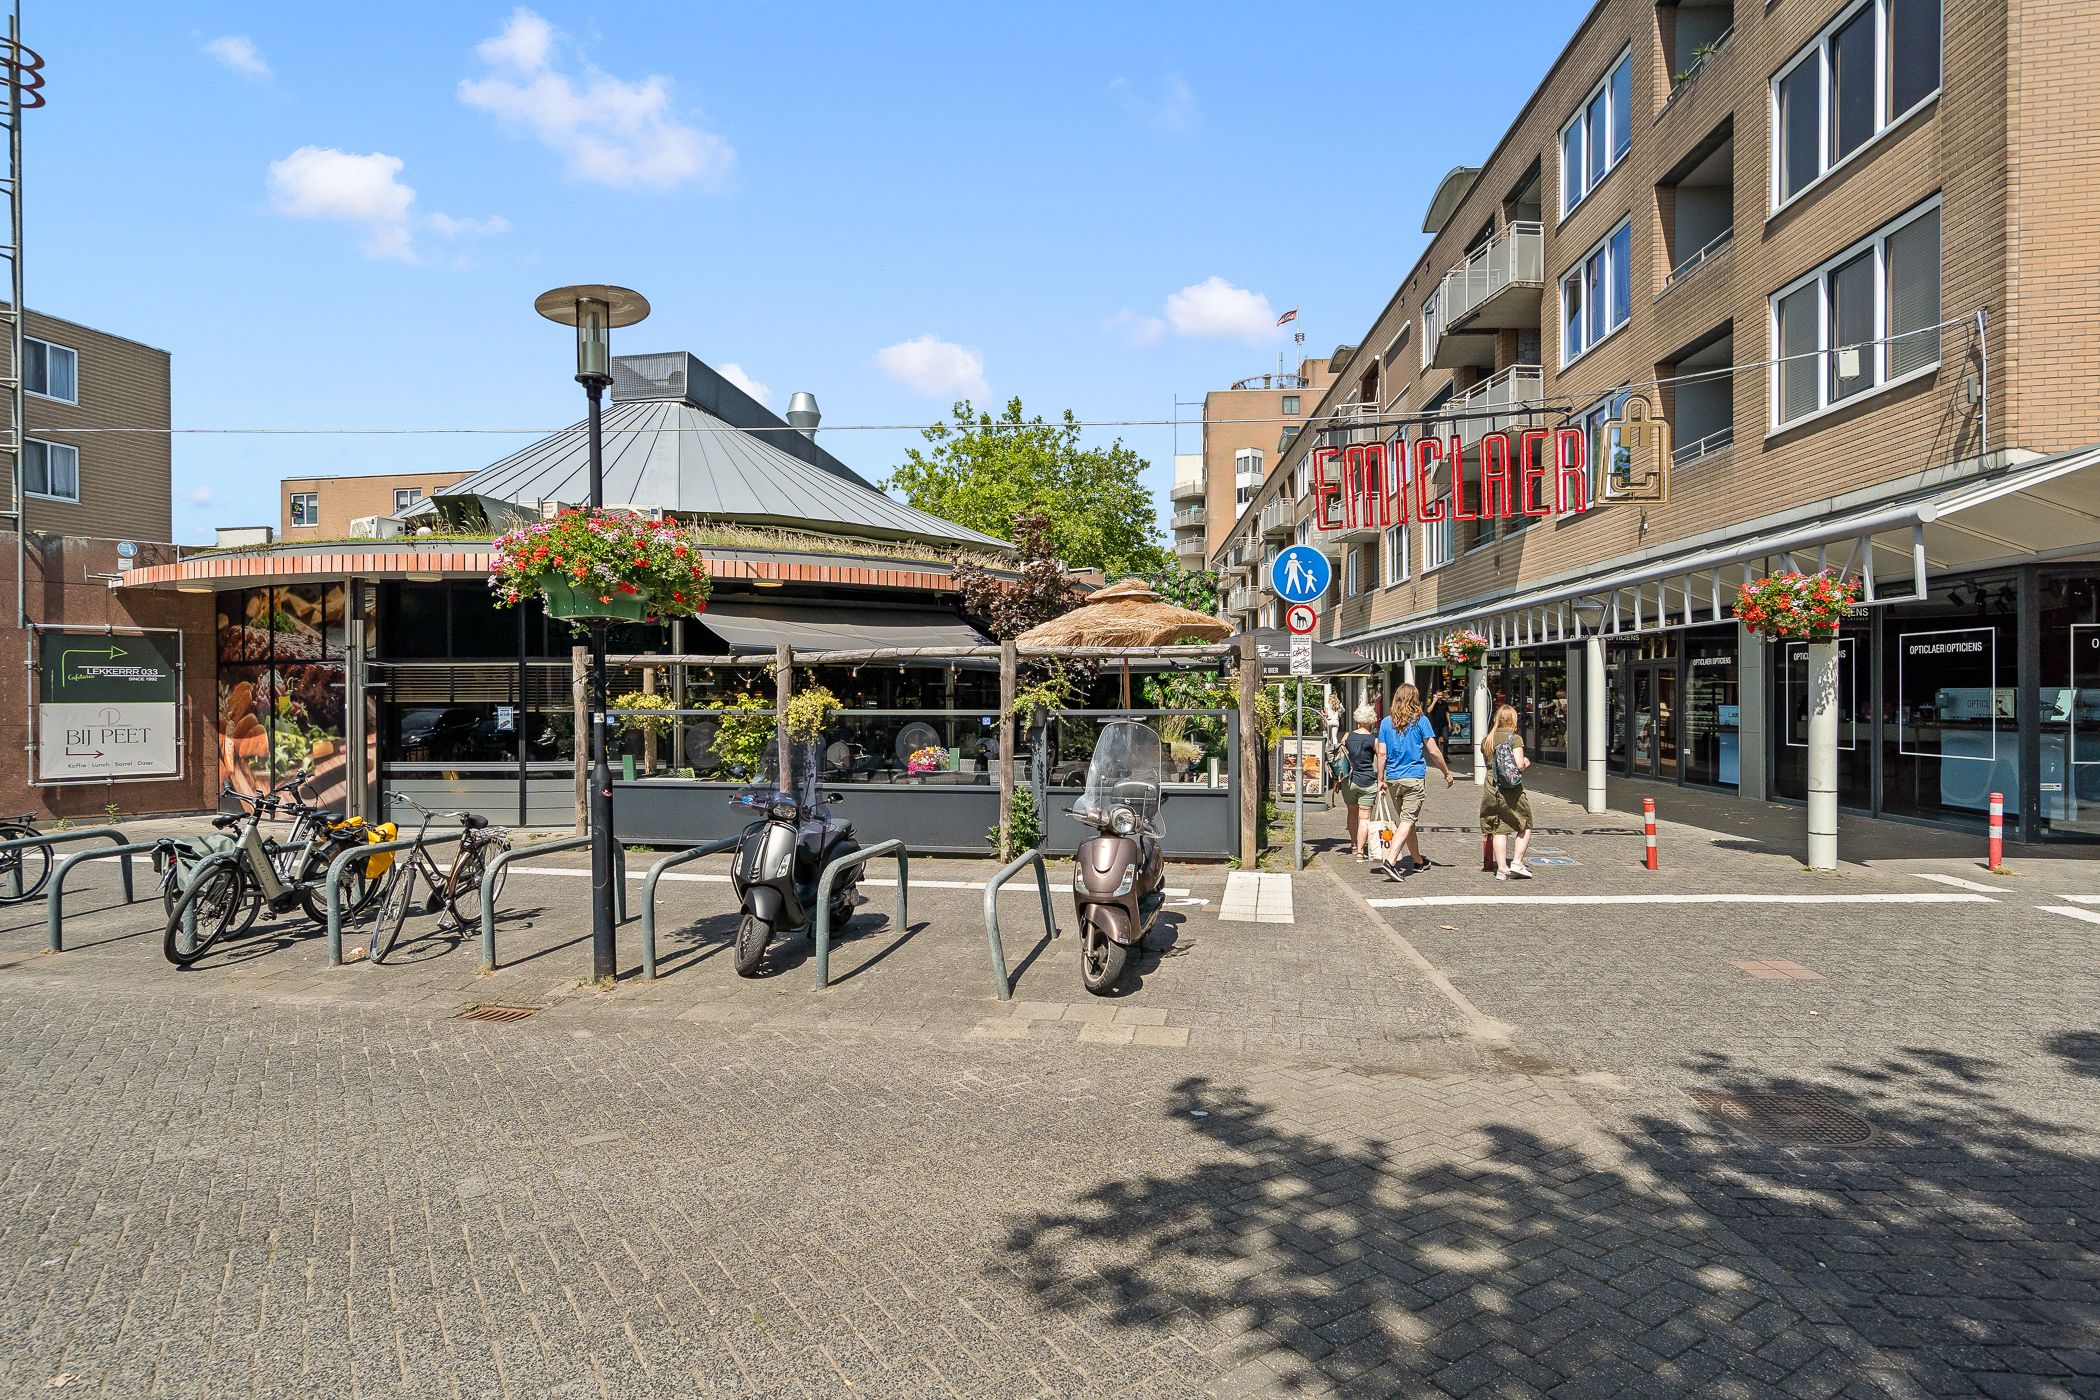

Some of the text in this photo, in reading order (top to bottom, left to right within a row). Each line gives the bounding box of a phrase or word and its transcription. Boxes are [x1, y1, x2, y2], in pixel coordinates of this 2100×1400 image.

[1314, 425, 1586, 531] EMICLAER
[1909, 642, 1983, 655] OPTICLAER OPTICIENS
[1793, 651, 1809, 661] OPTICL
[66, 728, 152, 747] BIJ PEET
[67, 761, 87, 769] Koffie
